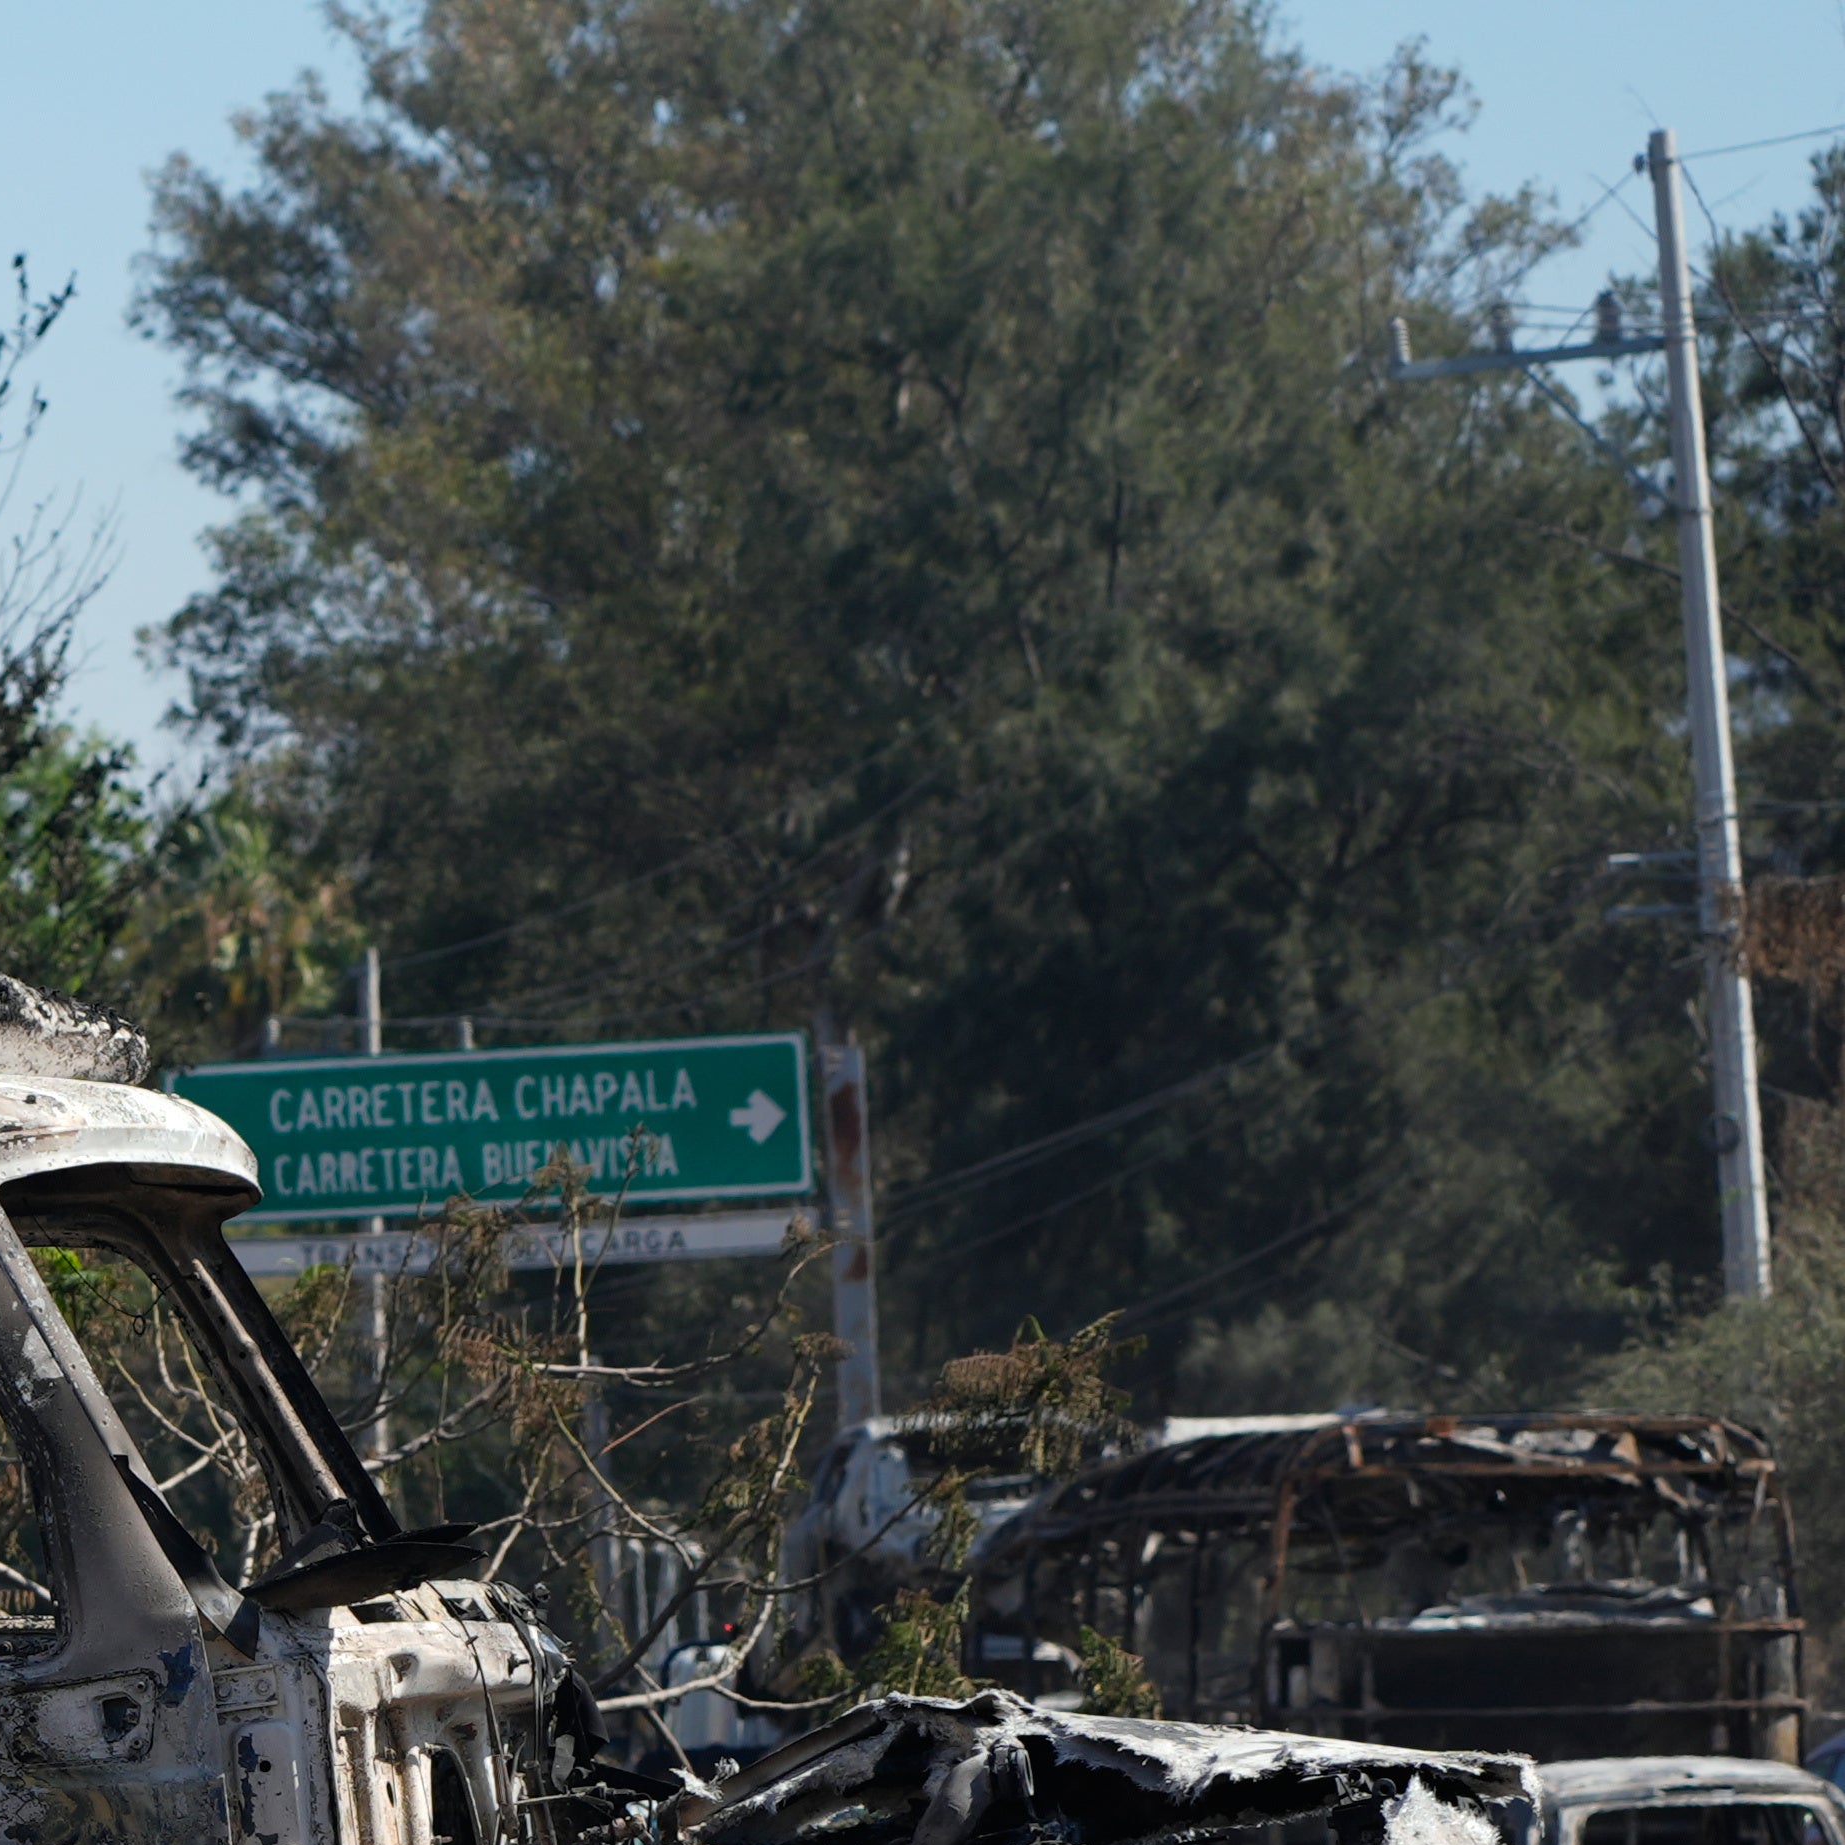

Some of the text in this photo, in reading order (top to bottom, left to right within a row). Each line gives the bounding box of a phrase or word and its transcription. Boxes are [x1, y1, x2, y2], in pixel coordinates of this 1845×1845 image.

[270, 1068, 698, 1133] CARRETERA CHAPALA
[274, 1146, 464, 1196] CARRETERA
[579, 1229, 687, 1254] CARGA
